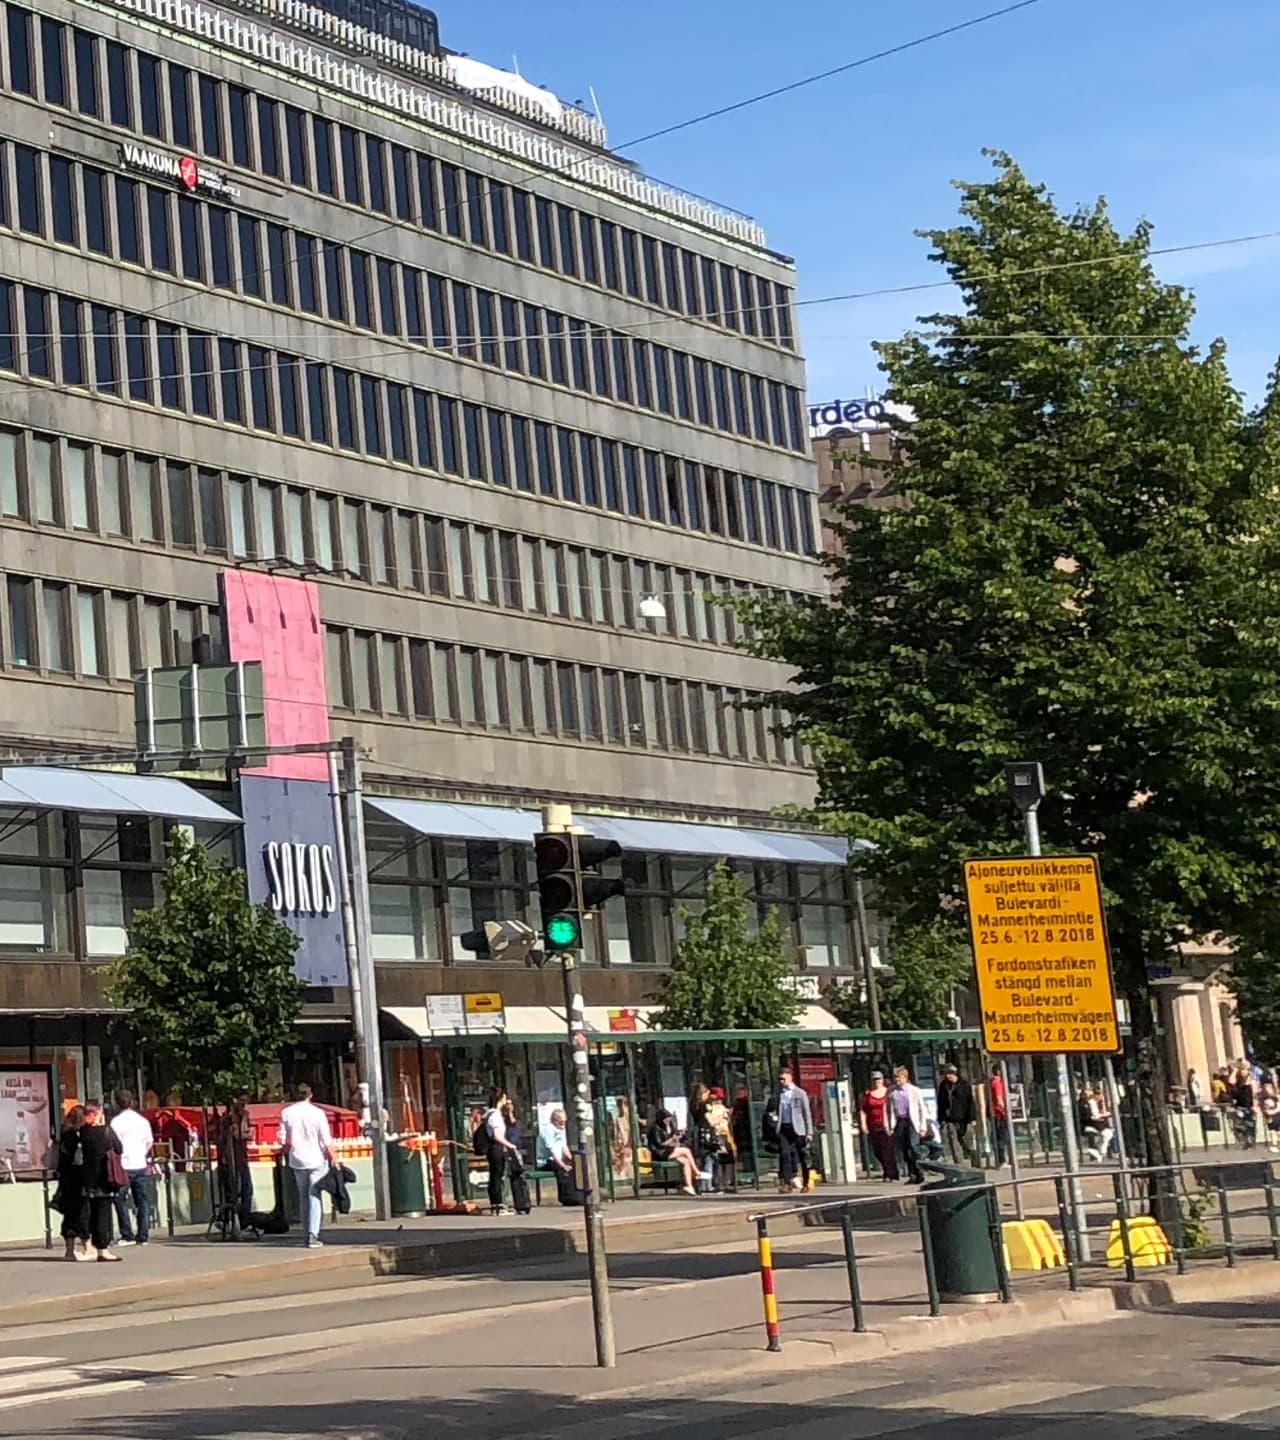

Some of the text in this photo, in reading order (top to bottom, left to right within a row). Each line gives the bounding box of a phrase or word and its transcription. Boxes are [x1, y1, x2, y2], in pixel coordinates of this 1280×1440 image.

[123, 143, 182, 178] VAAKUNA
[268, 840, 336, 913] SOKOS
[984, 878, 1081, 895] suljettu välillä
[978, 912, 1094, 927] Mannerheimintie
[987, 958, 1096, 973] Fordonstrafiken
[995, 975, 1092, 991] stängd mellan
[985, 1009, 1113, 1025] Mannerheimvägen
